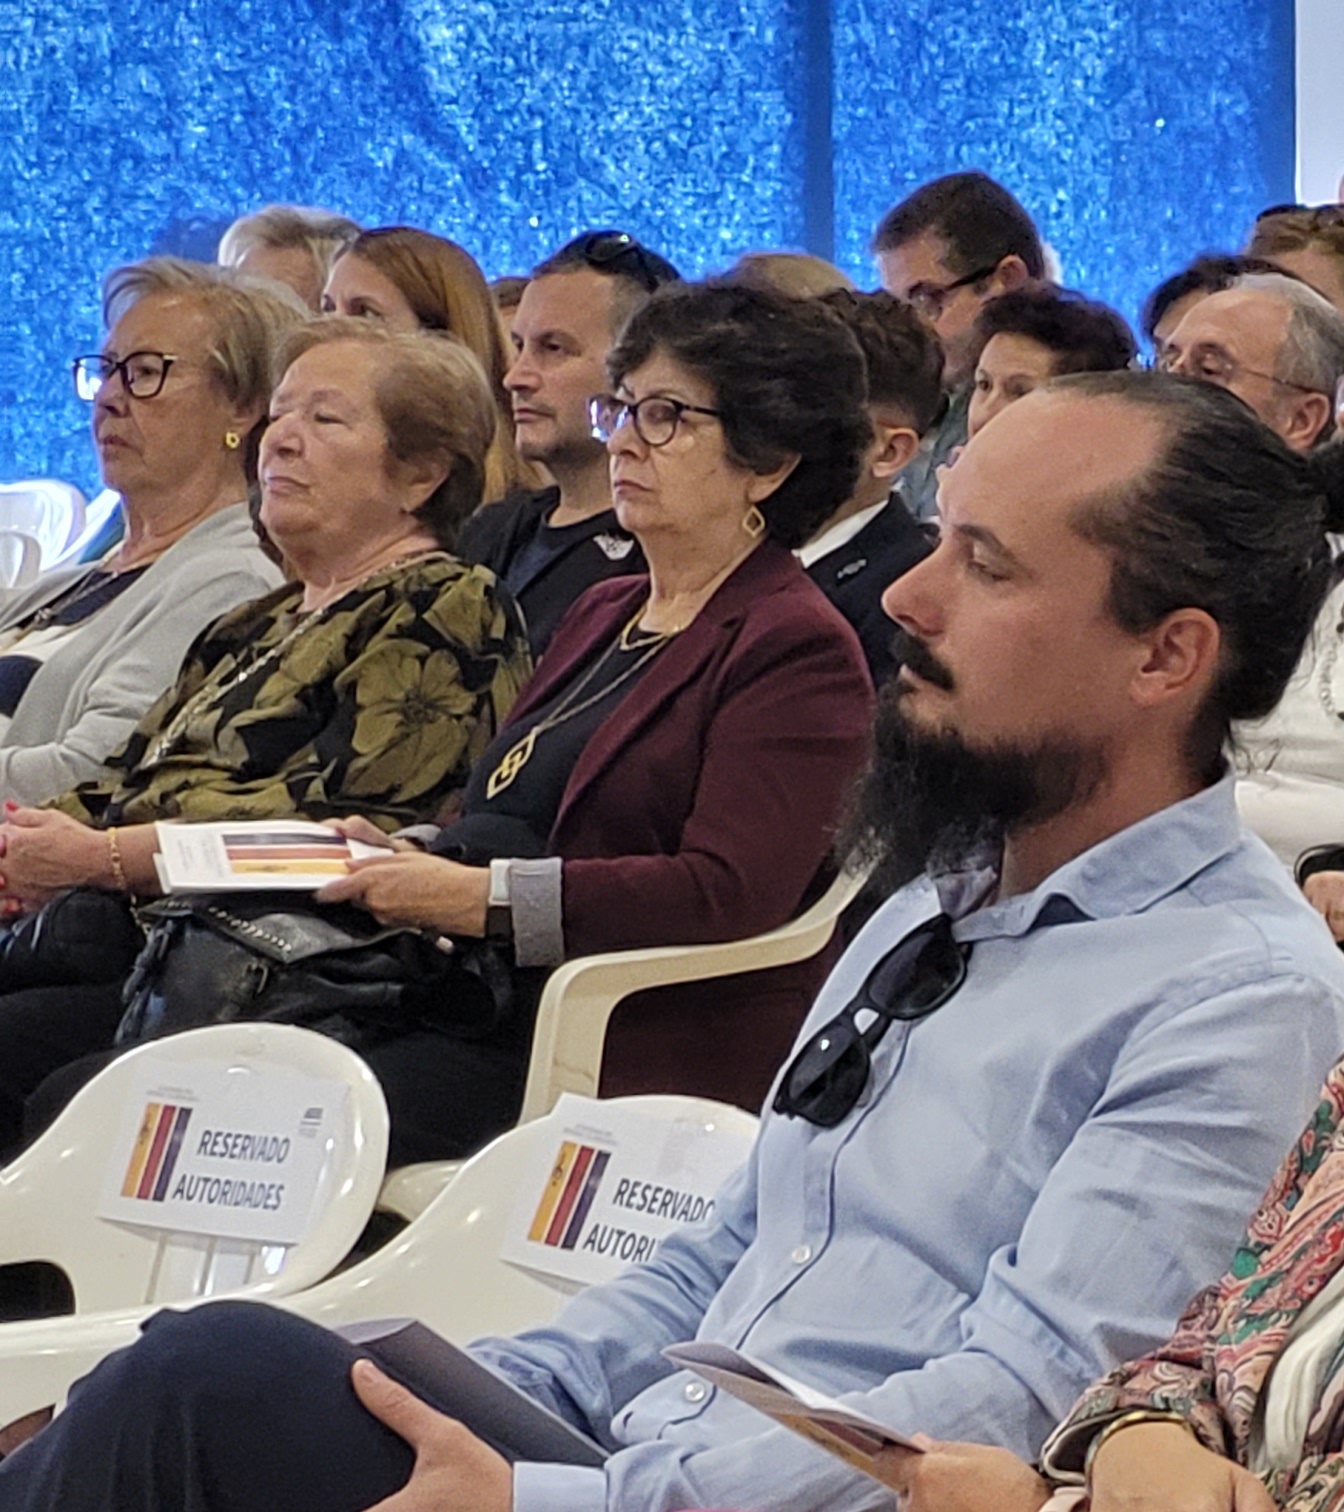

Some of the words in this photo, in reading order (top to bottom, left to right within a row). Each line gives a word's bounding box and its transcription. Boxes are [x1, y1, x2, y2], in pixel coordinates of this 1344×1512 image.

[198, 1130, 290, 1163] RESERVADO
[173, 1173, 285, 1210] AUTORIDADES
[582, 1223, 660, 1263] AUTORI
